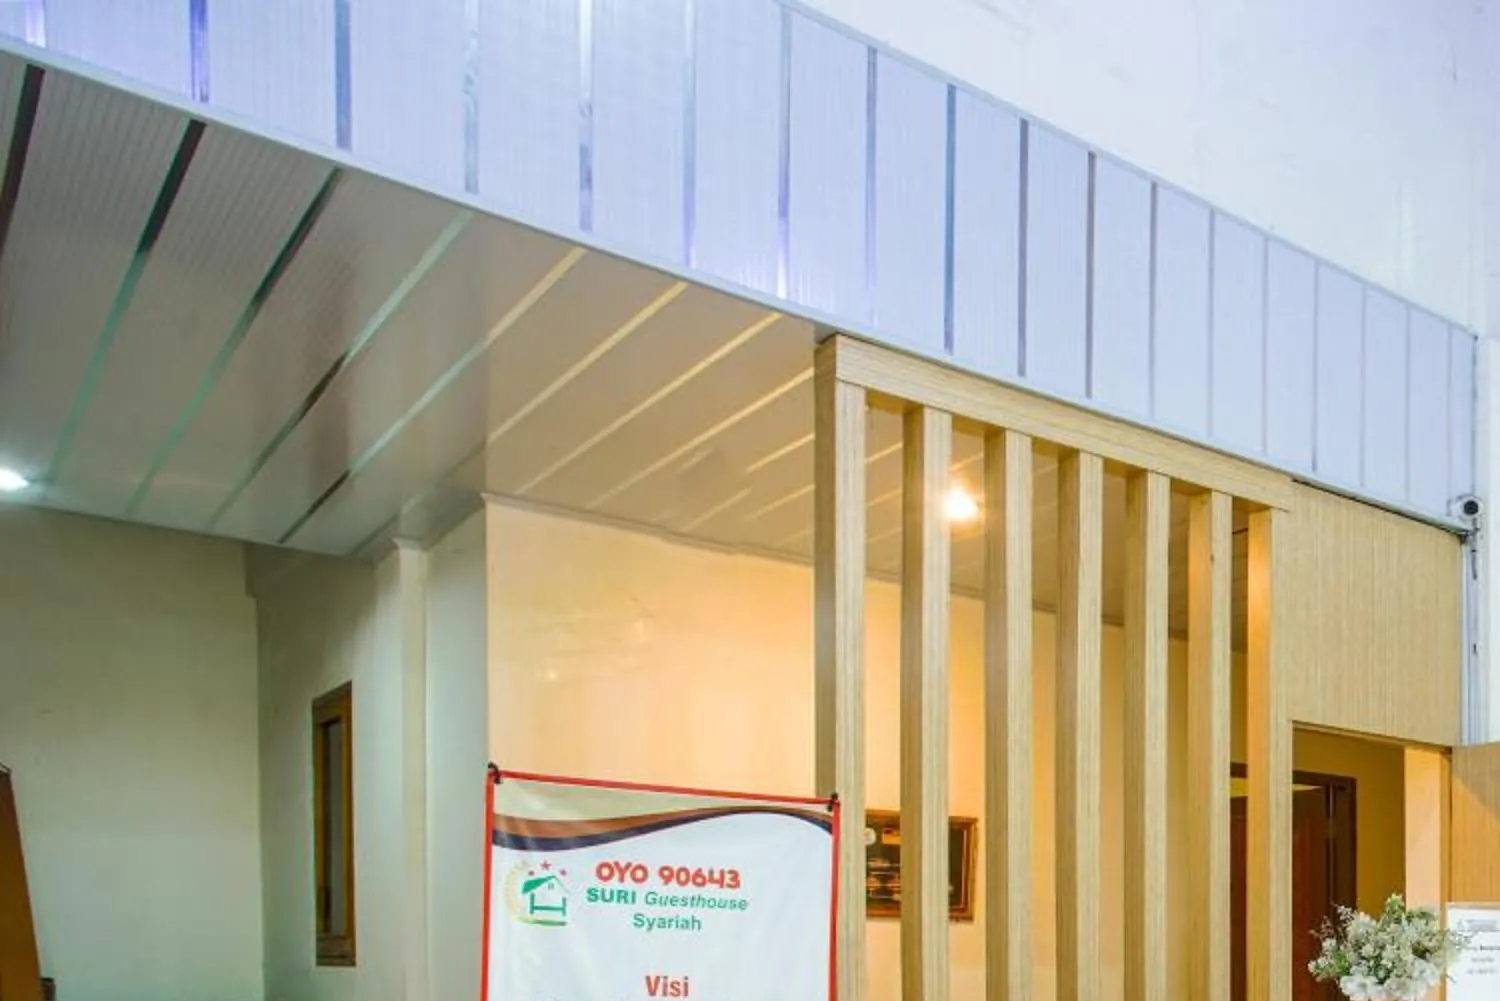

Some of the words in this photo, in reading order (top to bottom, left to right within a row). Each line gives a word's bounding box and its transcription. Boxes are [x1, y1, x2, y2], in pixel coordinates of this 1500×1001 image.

[596, 861, 648, 884] OYO
[659, 865, 741, 889] 90643
[586, 887, 636, 905] SURI
[645, 892, 748, 911] Guesthouse
[633, 913, 702, 931] Syariah
[645, 976, 689, 997] Visi
